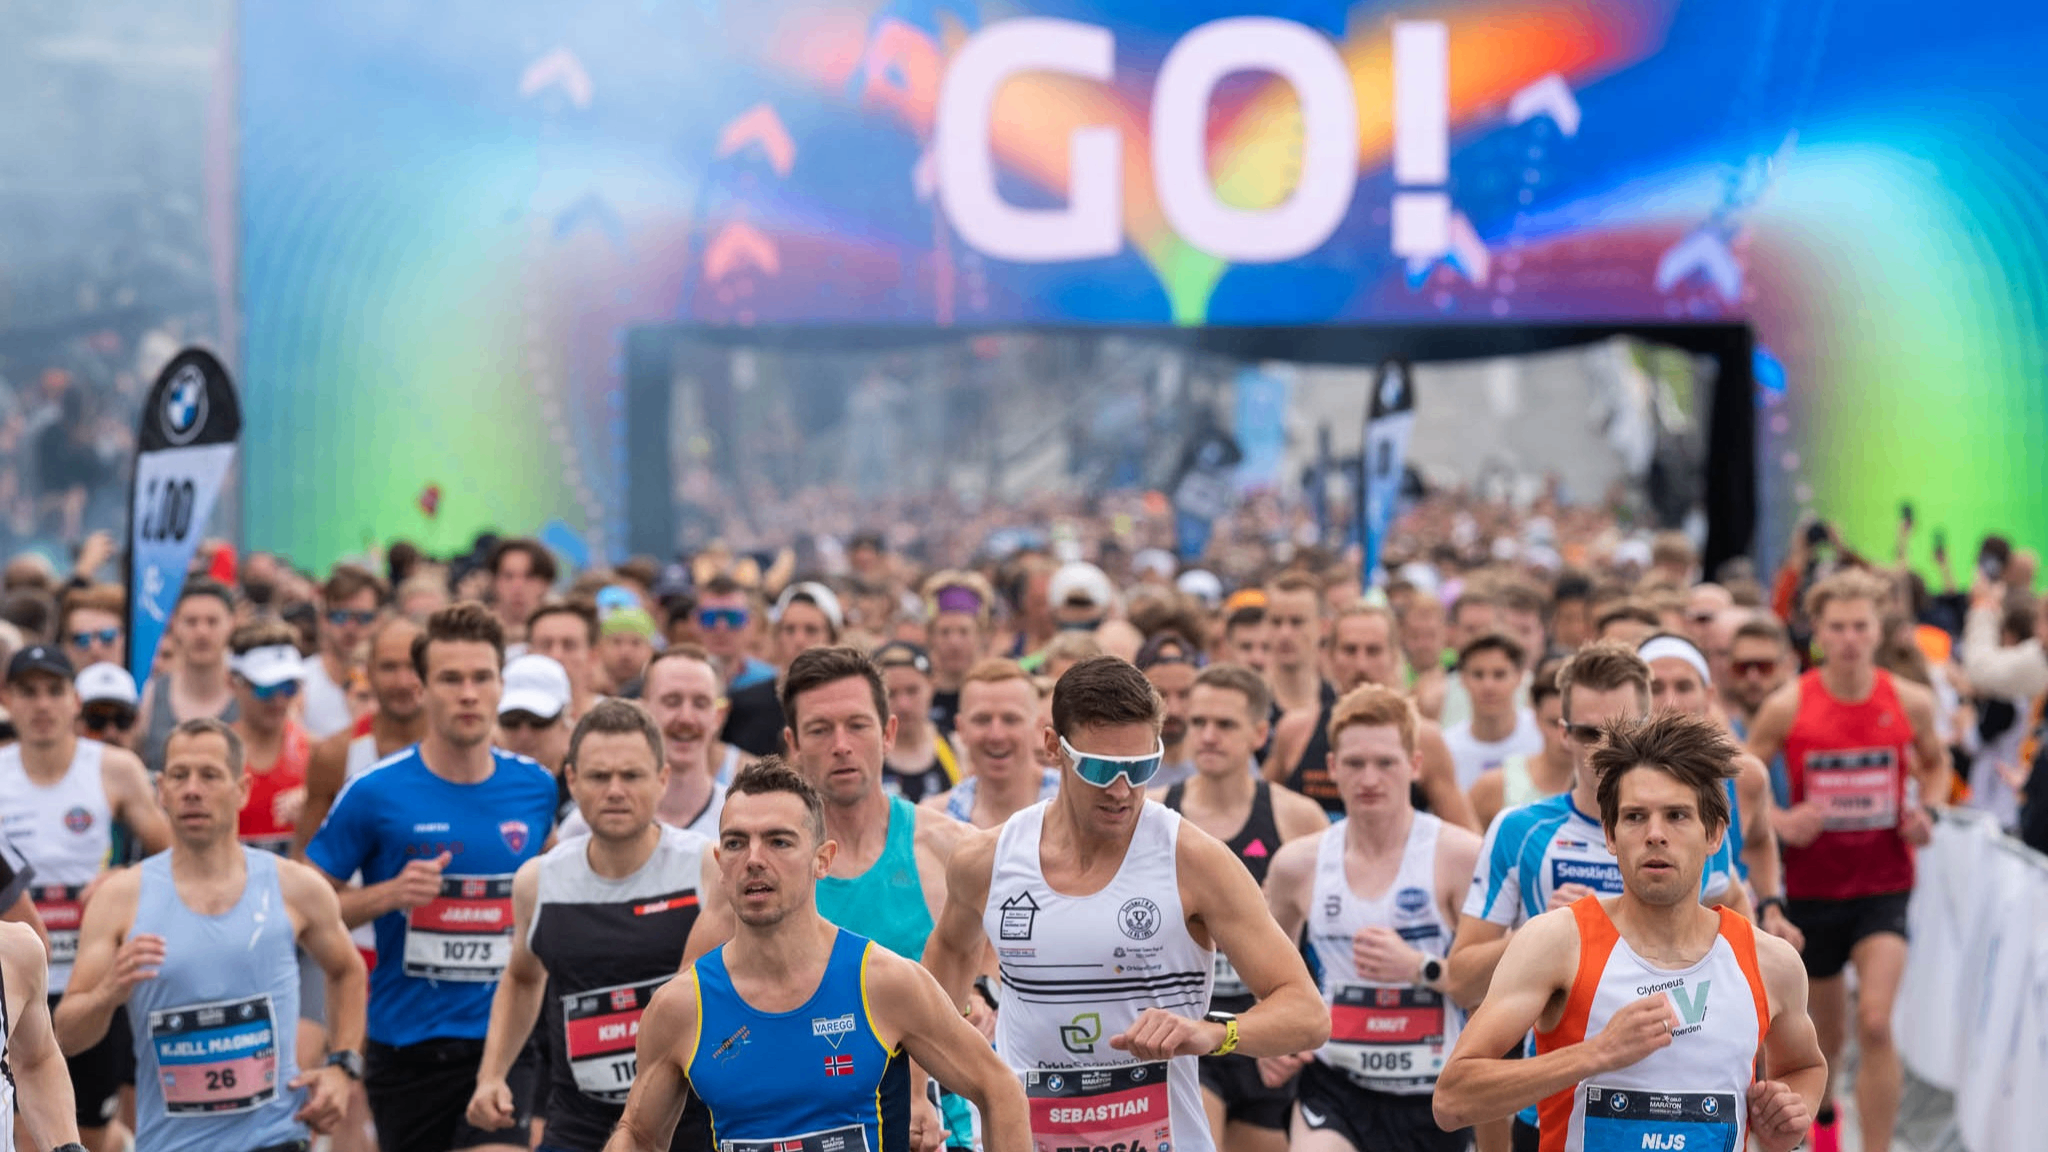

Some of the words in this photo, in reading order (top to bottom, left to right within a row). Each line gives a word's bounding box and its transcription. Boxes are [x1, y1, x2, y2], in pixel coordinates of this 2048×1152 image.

[935, 15, 1449, 263] GO!
[440, 907, 502, 923] JARAND
[443, 941, 492, 960] 1073
[1636, 978, 1684, 996] Clytoneus
[598, 1023, 626, 1042] KIM
[814, 1019, 853, 1033] VAREGG
[1366, 1017, 1409, 1032] KNUT
[208, 1029, 271, 1053] MAGNUS
[1360, 1052, 1412, 1070] 1085
[205, 1068, 237, 1091] 26
[1049, 1097, 1149, 1123] SEBASTIAN
[1649, 1101, 1681, 1109] MARATON
[1641, 1133, 1686, 1150] NIJS
